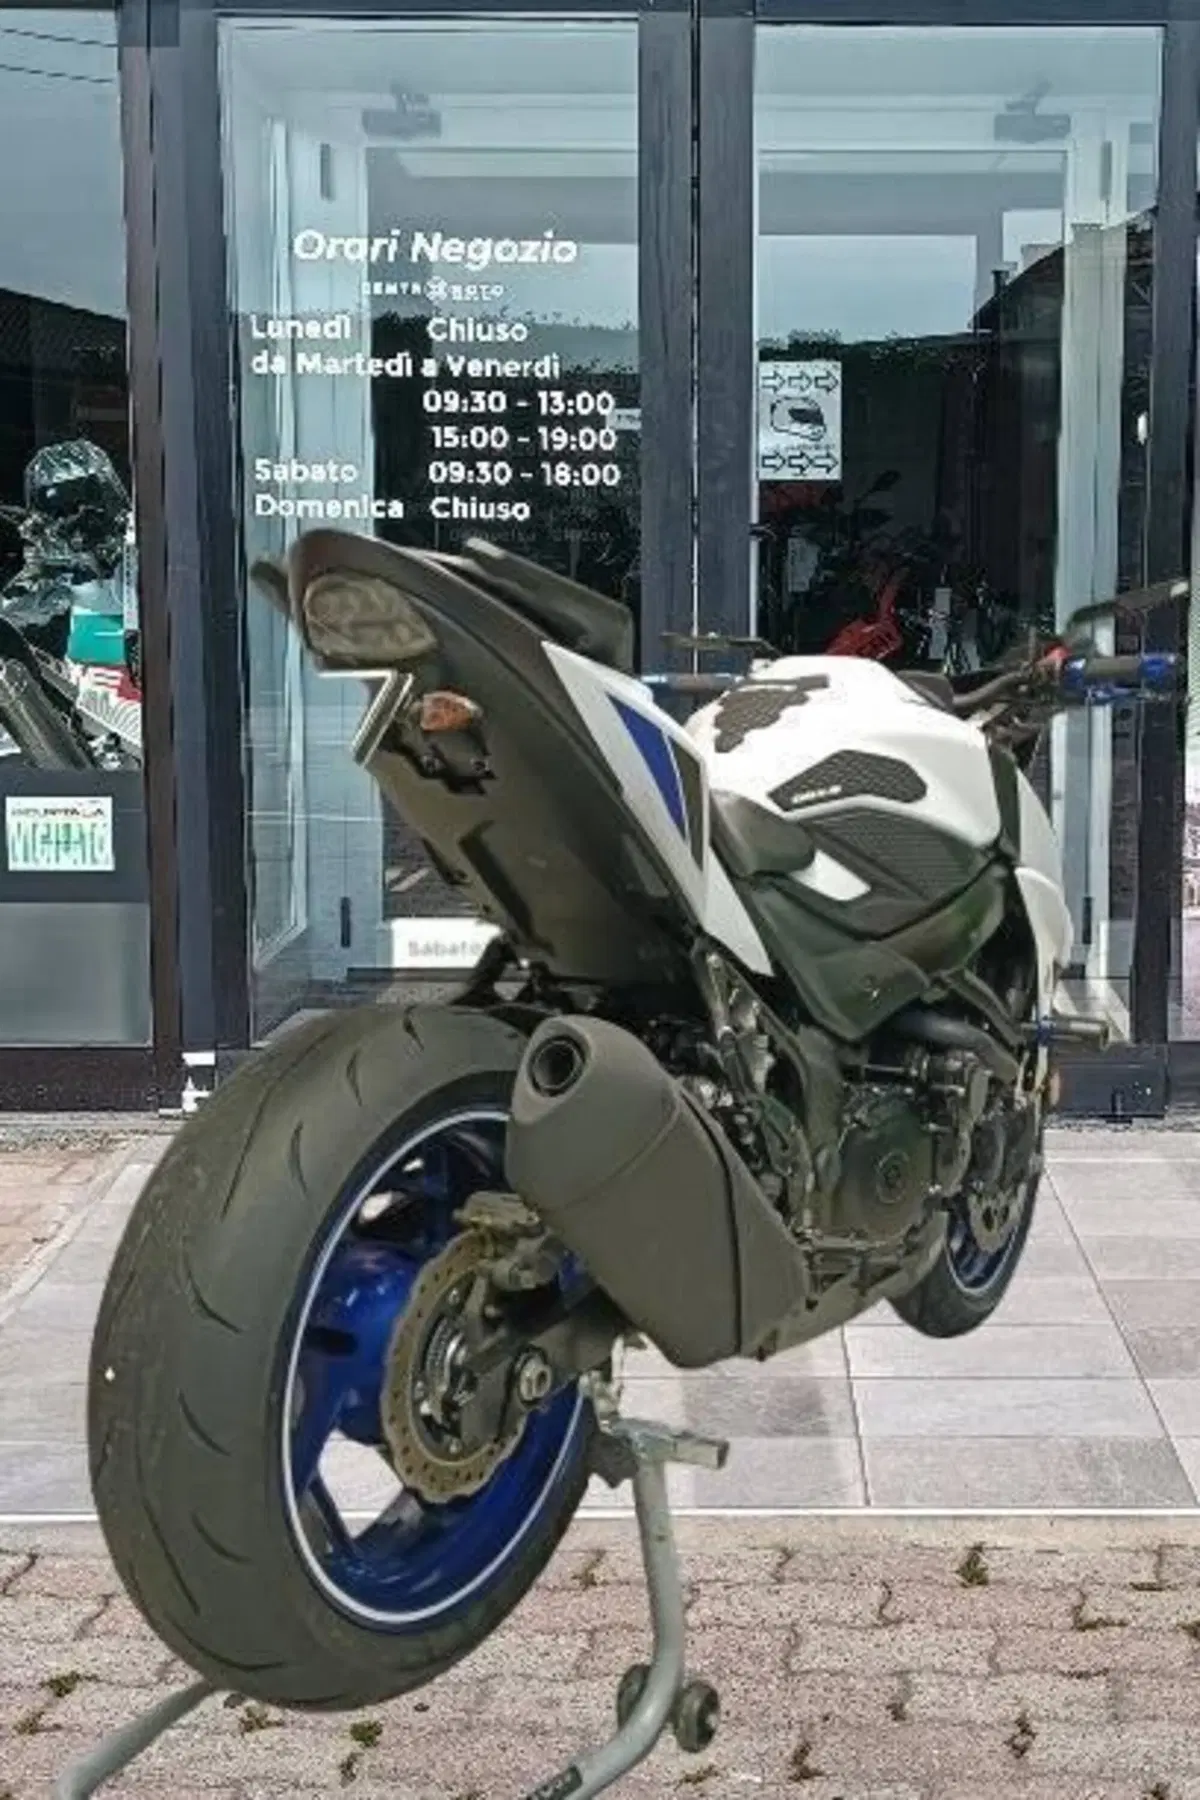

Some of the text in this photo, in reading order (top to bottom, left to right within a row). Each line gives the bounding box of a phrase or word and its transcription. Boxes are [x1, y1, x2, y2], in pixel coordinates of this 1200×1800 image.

[293, 229, 578, 271] Orari Negozio
[427, 317, 529, 342] Chiuso
[251, 349, 286, 375] da
[420, 358, 439, 378] a
[423, 390, 506, 414] 09:30
[537, 391, 615, 416] 13:00
[431, 426, 509, 450] 15:00
[539, 426, 617, 452] 19:00
[253, 458, 359, 484] Sabato
[428, 461, 513, 486] 09:30
[542, 461, 621, 487] 18:00
[254, 494, 531, 522] Domenica Chiuso
